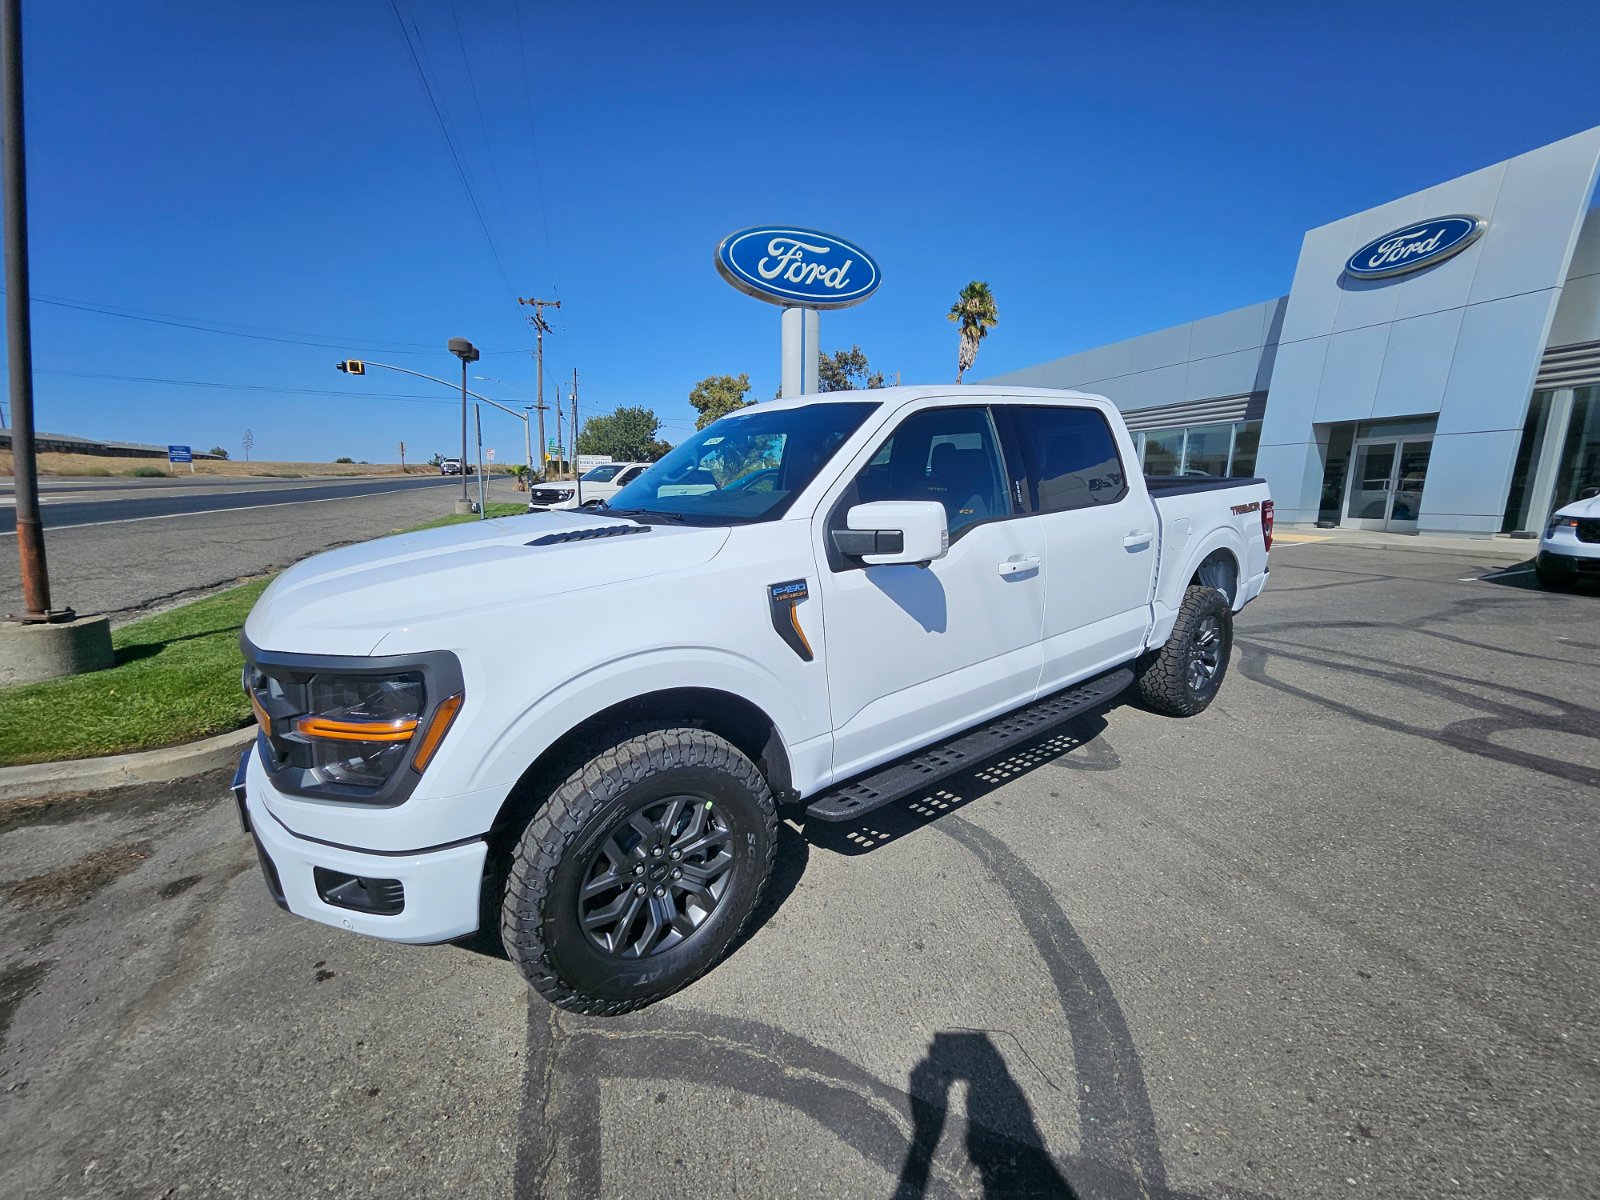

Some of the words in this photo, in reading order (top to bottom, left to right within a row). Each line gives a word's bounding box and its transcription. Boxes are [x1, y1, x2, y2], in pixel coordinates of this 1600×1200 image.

[757, 237, 853, 290] Ford
[1368, 228, 1447, 268] Ford
[1230, 501, 1260, 516] TREMOR
